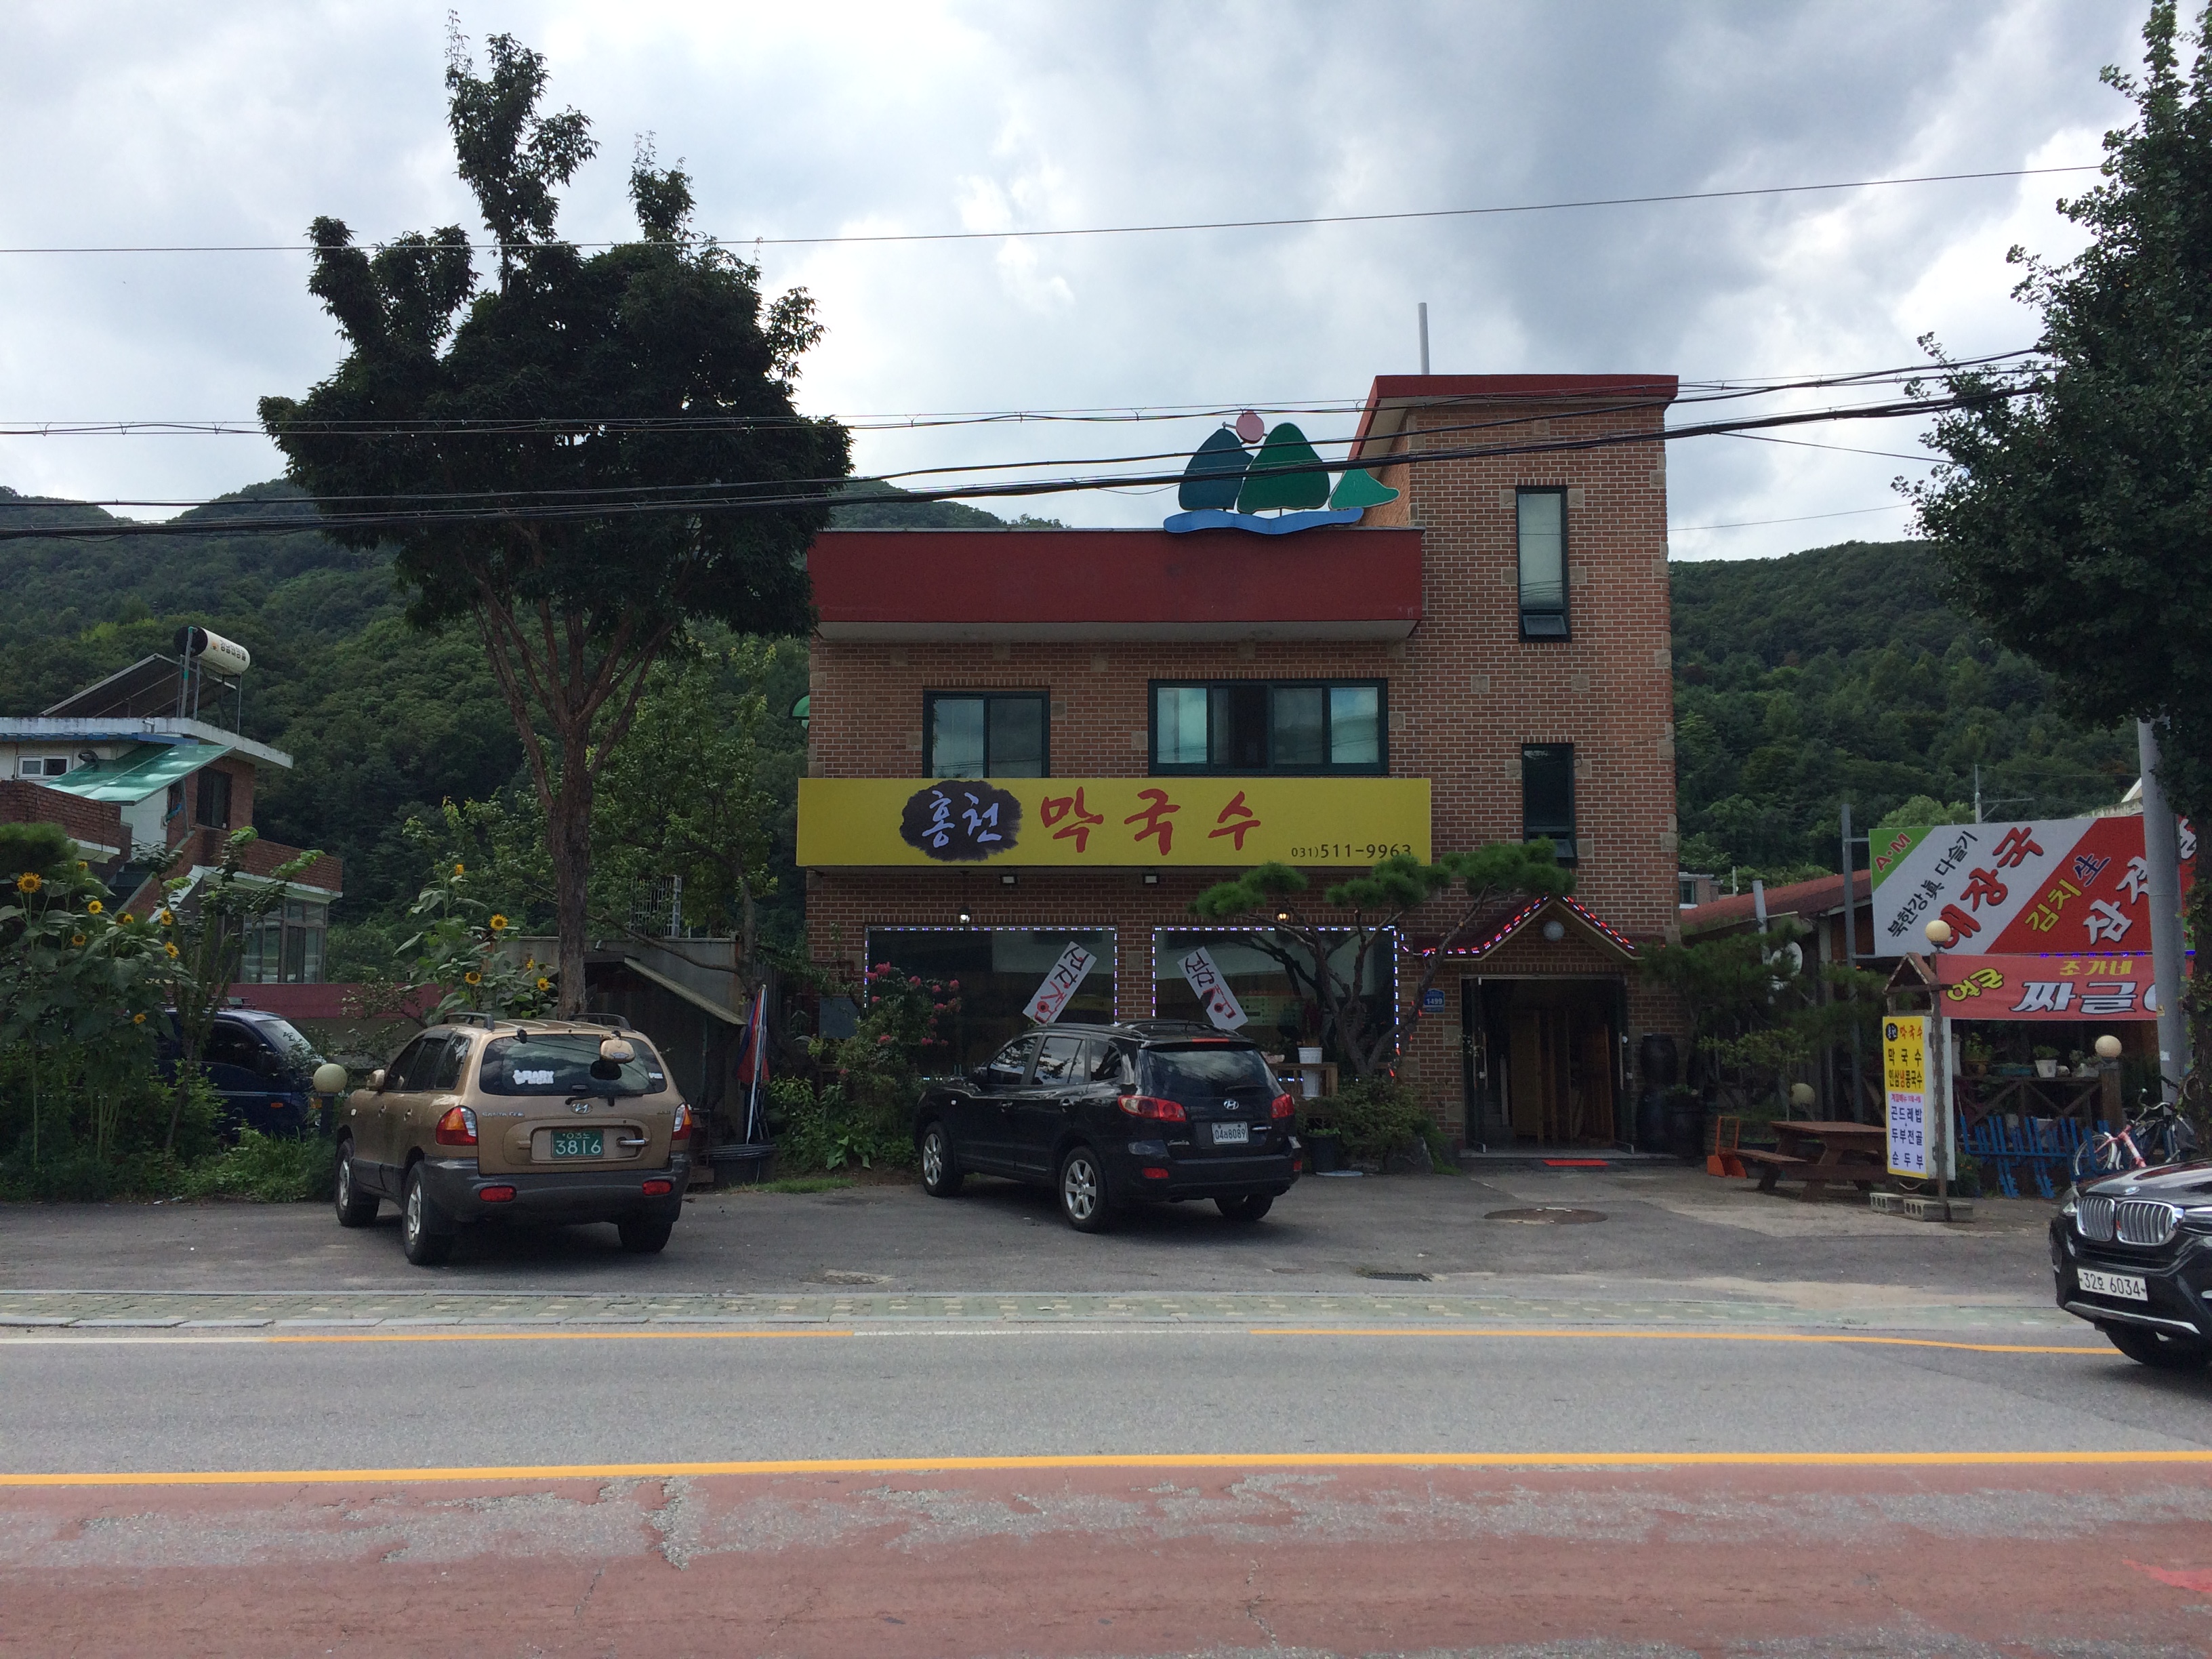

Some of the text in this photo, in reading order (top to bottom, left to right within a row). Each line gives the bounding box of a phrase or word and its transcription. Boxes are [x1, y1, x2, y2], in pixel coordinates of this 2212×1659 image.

[922, 786, 1261, 855] 홍천 막국수
[1934, 830, 1979, 876] 다슬기
[2060, 960, 2133, 976] 조가네
[1946, 968, 2003, 1001] 얼큰
[2009, 981, 2157, 1014] 짜글
[1887, 1048, 1922, 1067] 막국수
[1891, 1106, 1922, 1123] 곤드레밥
[1891, 1128, 1923, 1146] 두부전골
[556, 1139, 601, 1155] 3816
[1892, 1151, 1923, 1170] 순두부
[2083, 1272, 2141, 1297] 32호 6034
